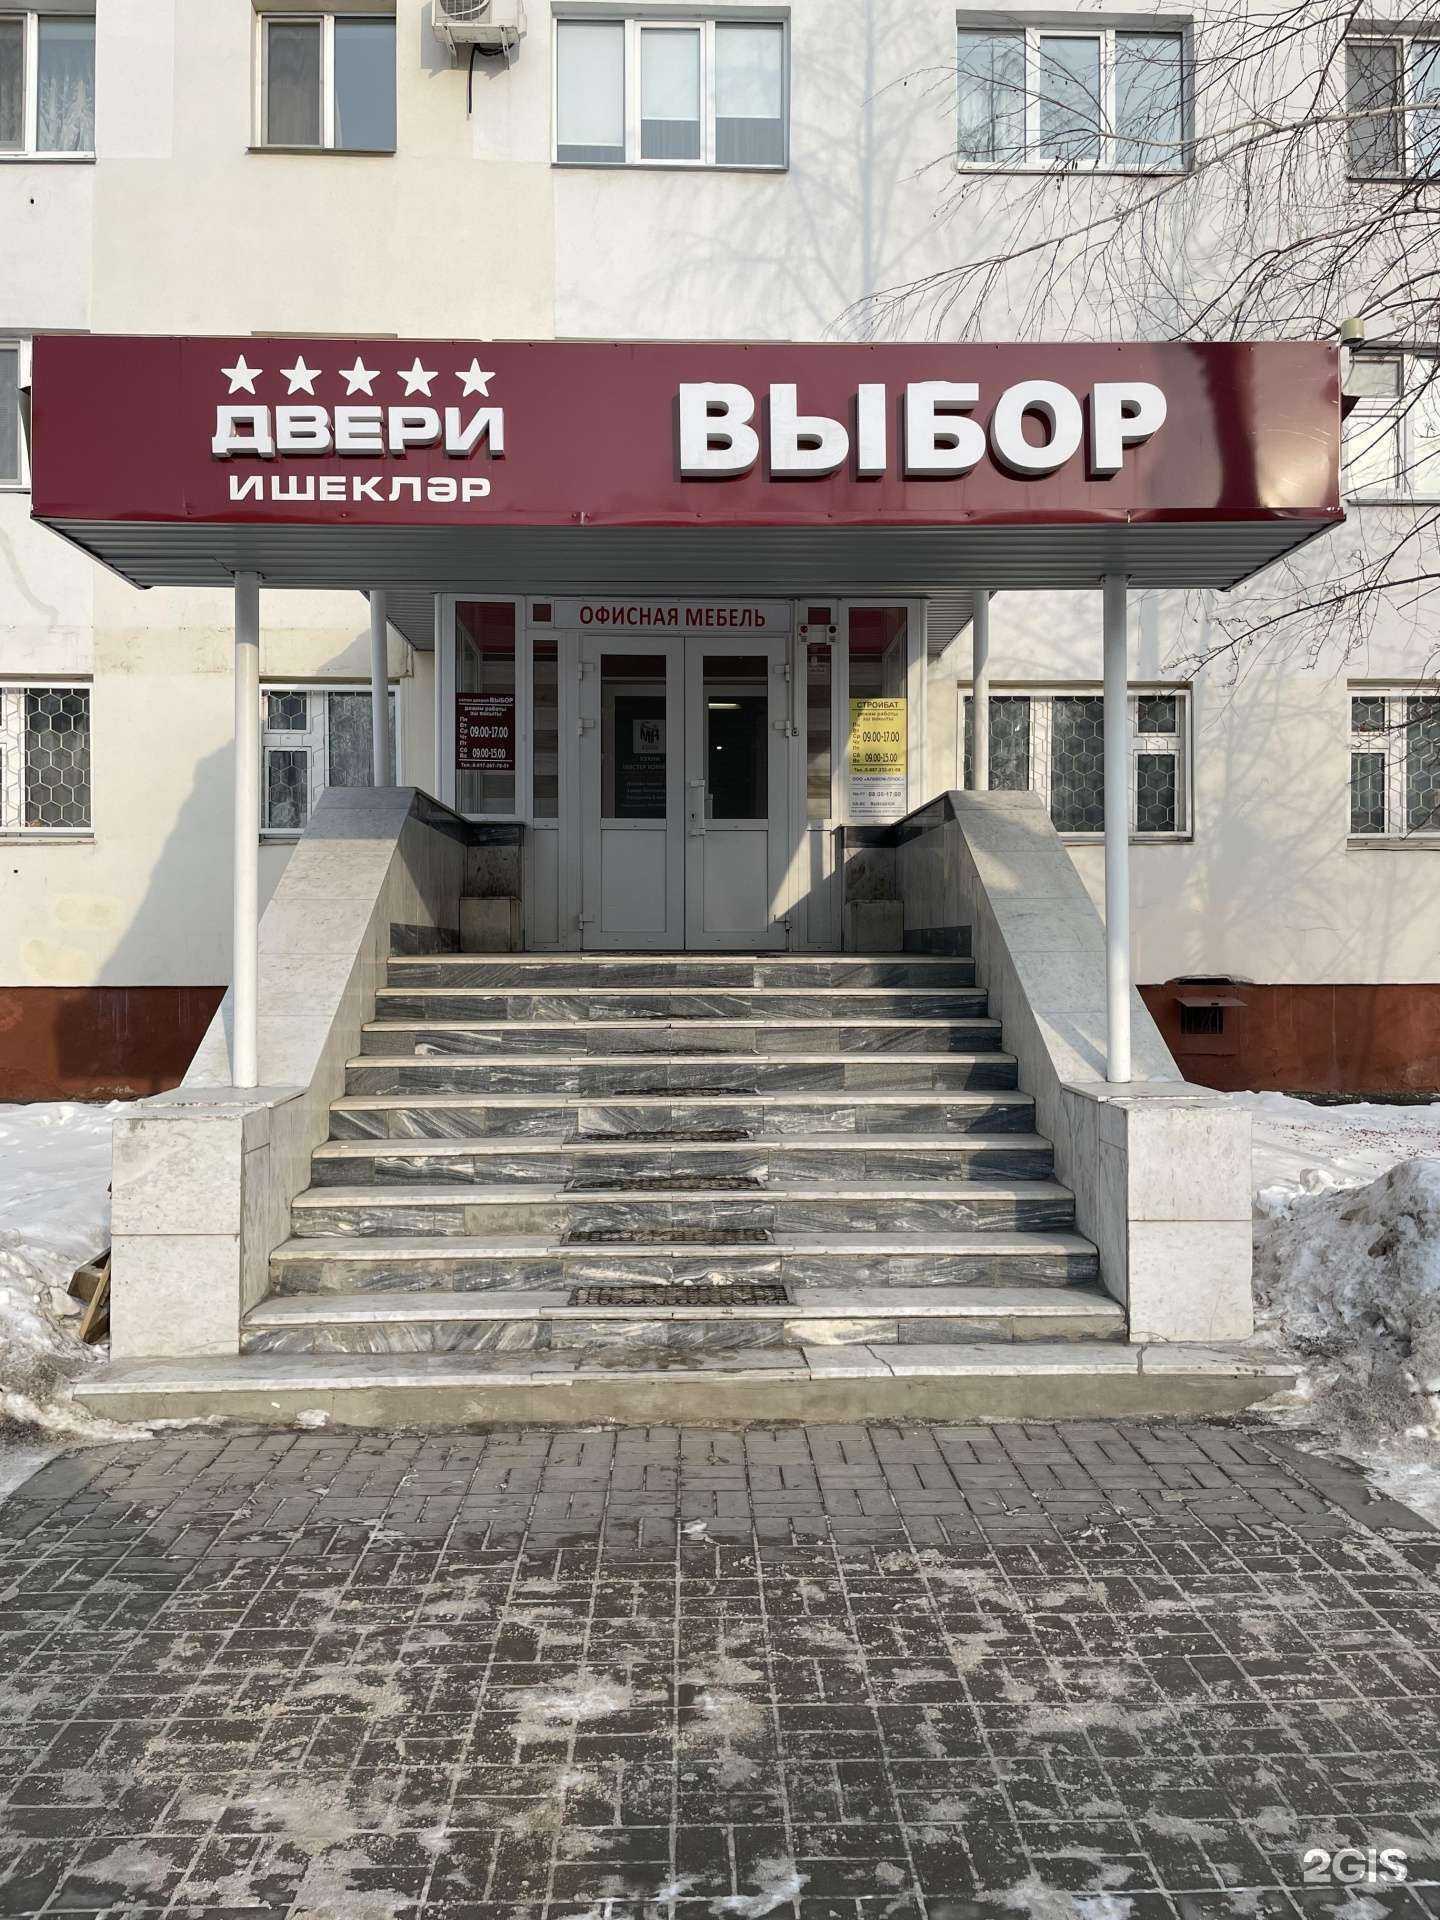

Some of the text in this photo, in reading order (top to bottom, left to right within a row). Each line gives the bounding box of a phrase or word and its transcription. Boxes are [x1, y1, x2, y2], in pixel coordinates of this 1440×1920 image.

[211, 405, 505, 459] ДВЕРИ
[677, 379, 1168, 479] ВЫБОР
[579, 605, 767, 627] ОФИСНАЯ МЕБЕЛЬ
[856, 700, 899, 709] СТРОЙБАТ
